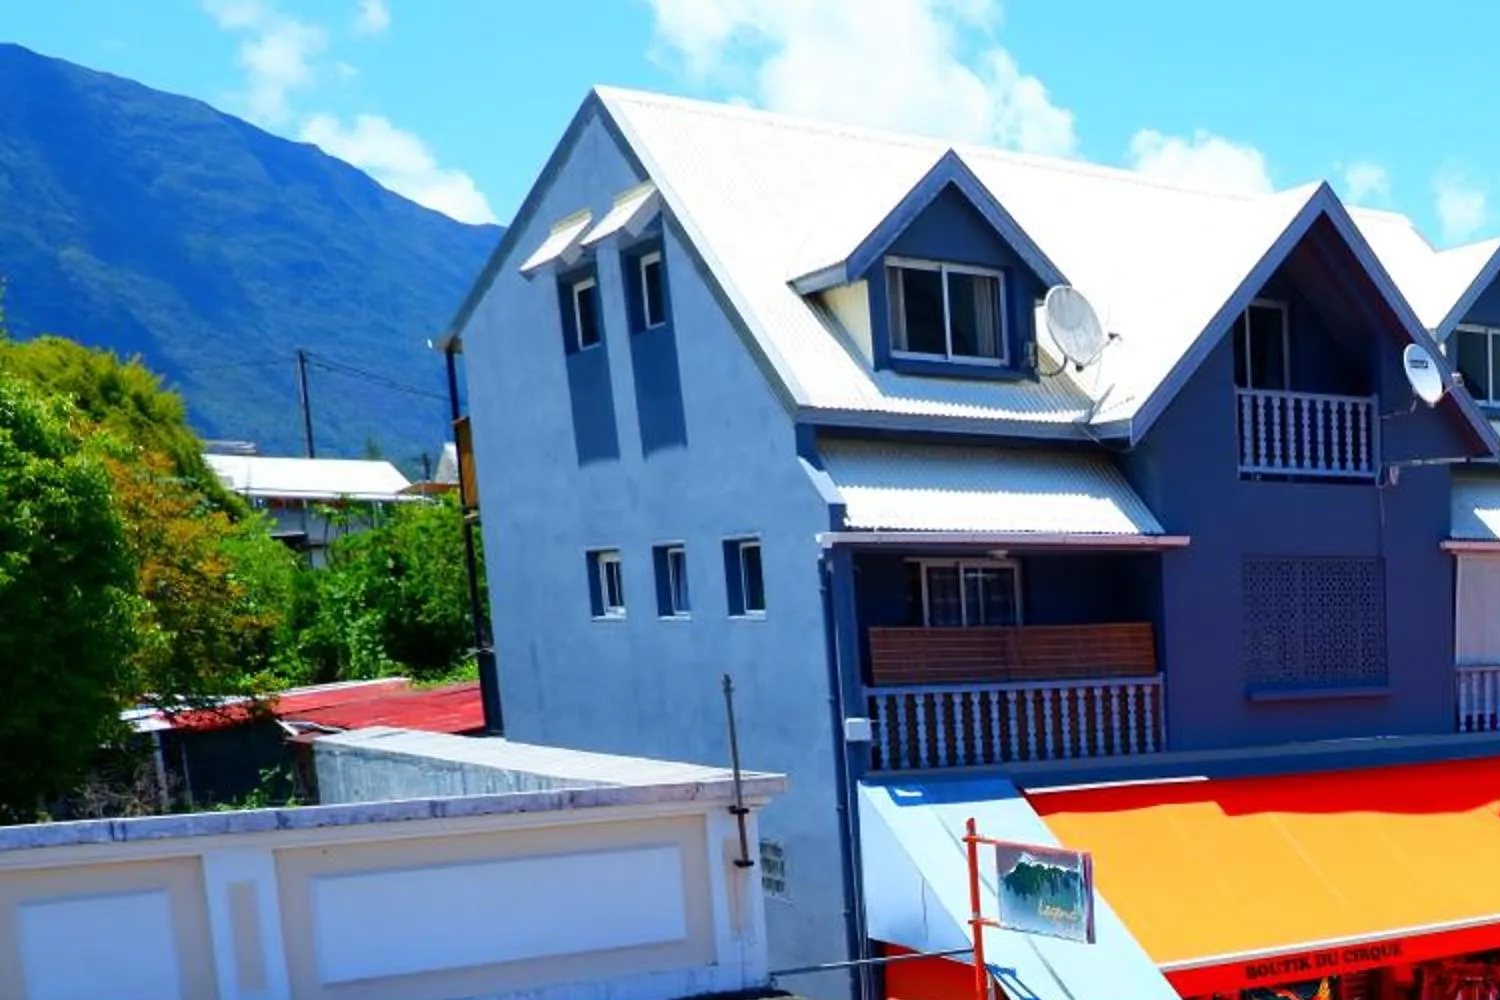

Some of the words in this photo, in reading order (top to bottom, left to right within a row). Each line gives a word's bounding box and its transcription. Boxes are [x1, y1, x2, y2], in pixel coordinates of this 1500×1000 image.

[1246, 957, 1311, 980] BOUTIK
[1314, 951, 1338, 968] DU
[1343, 944, 1401, 963] CIRQUE
